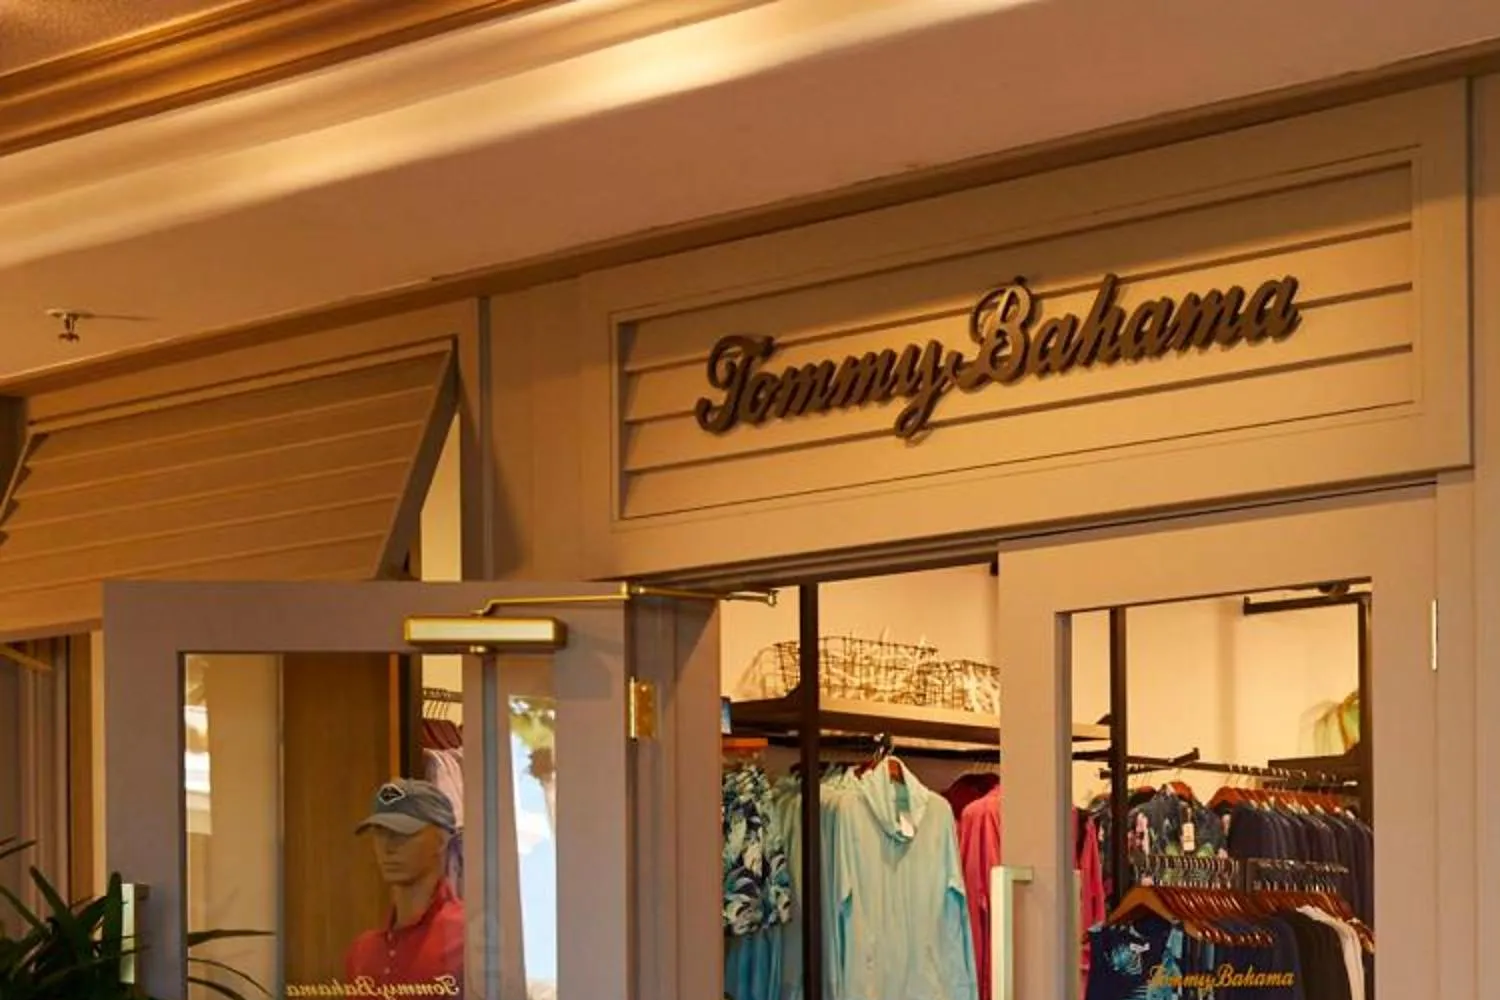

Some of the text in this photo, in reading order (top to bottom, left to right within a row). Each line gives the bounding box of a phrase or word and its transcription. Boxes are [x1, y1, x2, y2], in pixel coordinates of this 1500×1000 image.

[694, 272, 1302, 438] Tommy Bahama
[1146, 962, 1296, 993] Tommy Bahama
